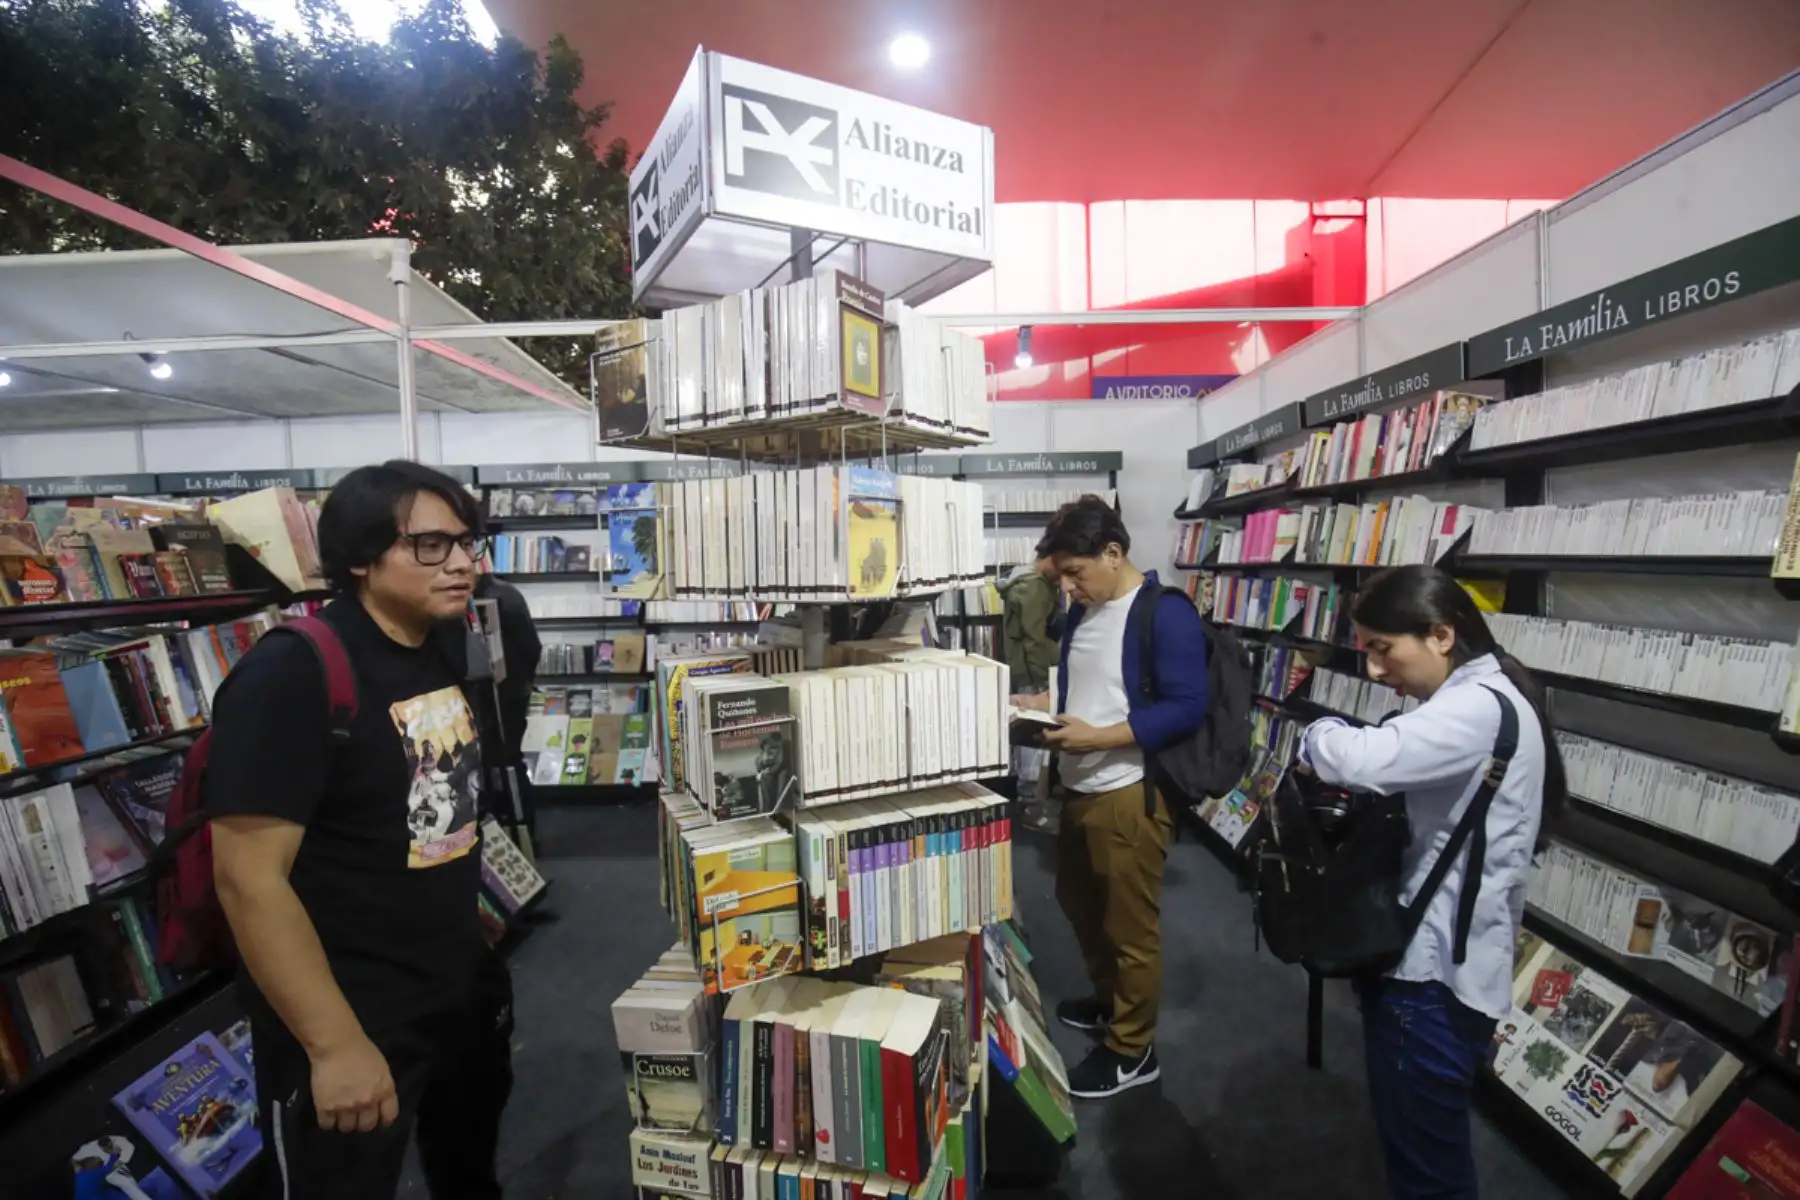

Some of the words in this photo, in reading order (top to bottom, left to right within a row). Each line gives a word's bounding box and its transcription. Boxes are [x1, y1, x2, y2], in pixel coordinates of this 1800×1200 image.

[658, 106, 694, 181] Alianza
[844, 117, 964, 174] Alianza
[659, 147, 704, 237] Editorial
[845, 178, 981, 236] Editorial
[1645, 271, 1741, 320] LIBROS
[1388, 372, 1430, 398] LIBROS
[254, 477, 291, 488] LIBROS
[1060, 461, 1098, 471] LIBROS
[637, 1059, 691, 1078] Crusoe
[1545, 1105, 1582, 1142] GOGOL
[637, 1157, 654, 1171] Los
